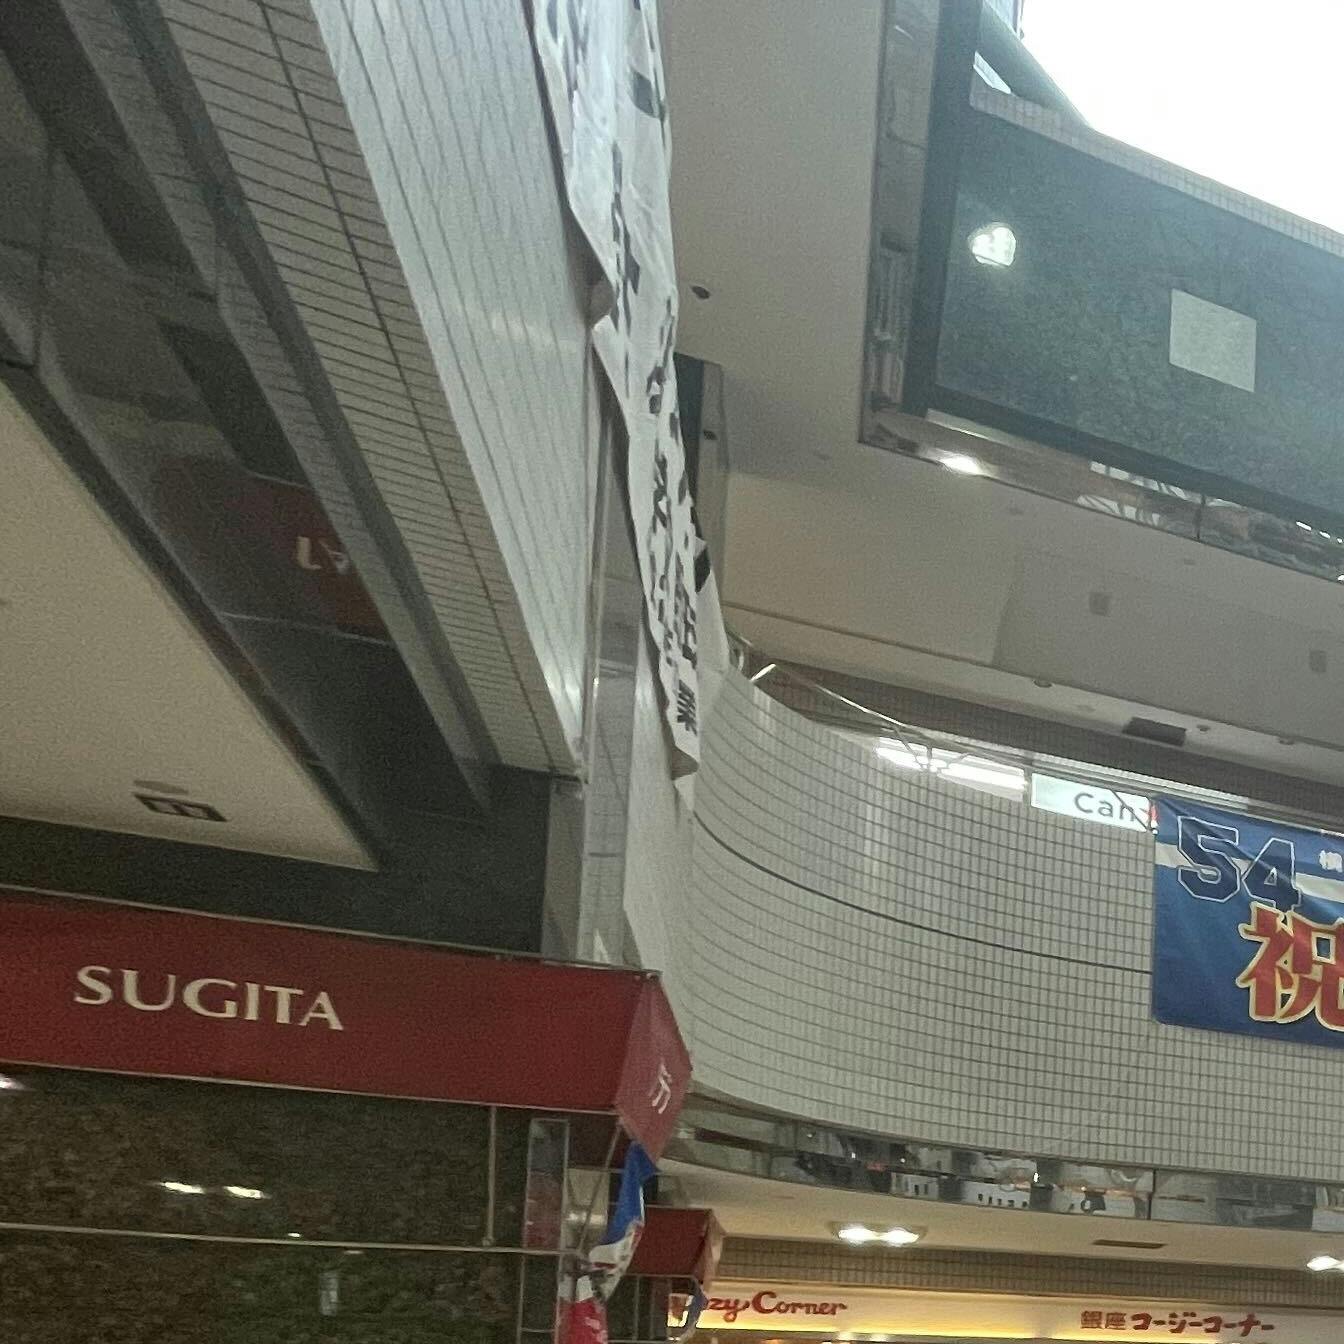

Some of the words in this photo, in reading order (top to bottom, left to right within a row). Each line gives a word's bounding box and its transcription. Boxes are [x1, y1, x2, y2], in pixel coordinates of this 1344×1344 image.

[1177, 815, 1302, 911] 54
[74, 964, 344, 1031] SUGITA
[752, 1291, 848, 1316] Corner
[1081, 1310, 1275, 1337] 銀座コージーコーナー
